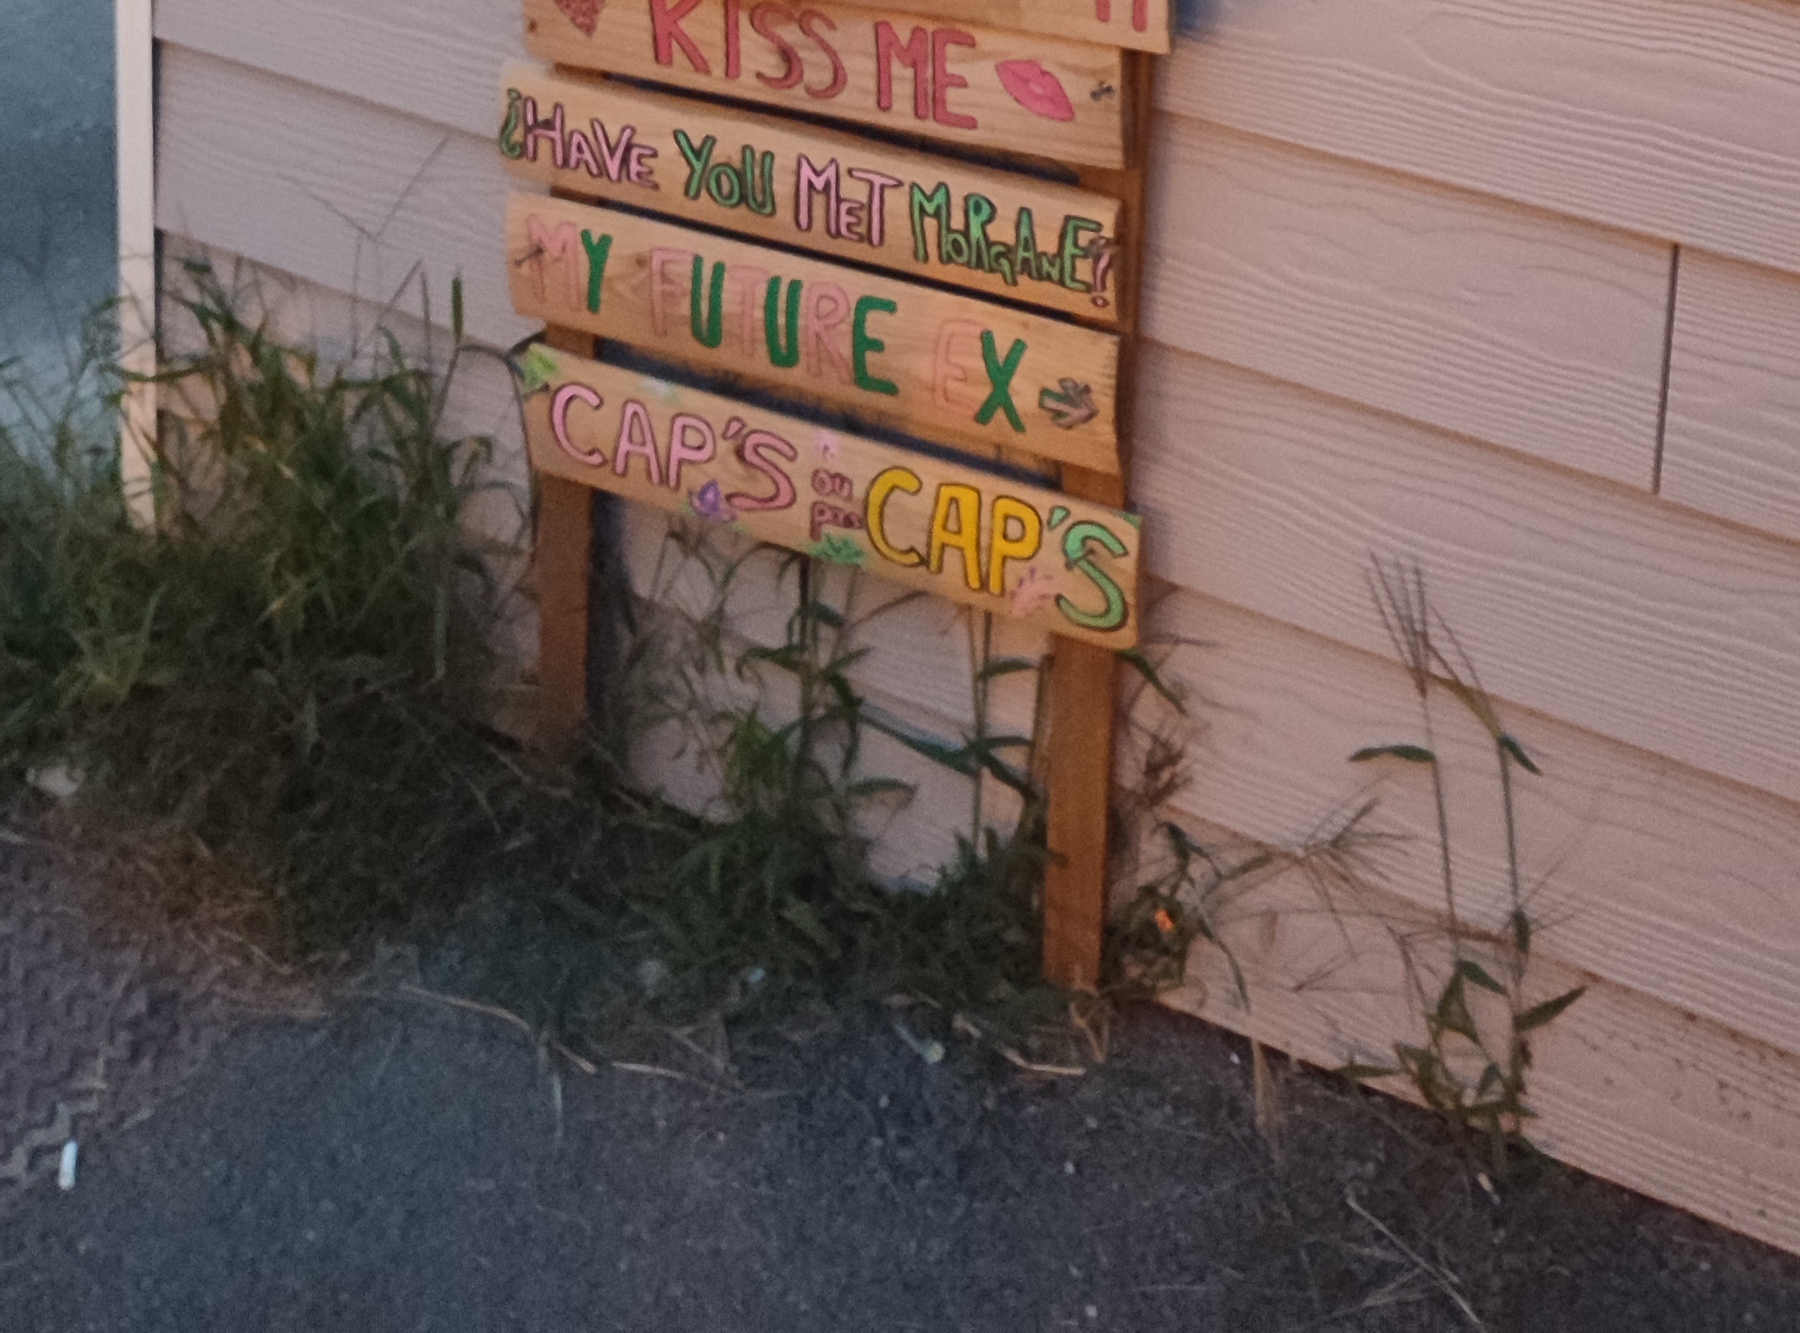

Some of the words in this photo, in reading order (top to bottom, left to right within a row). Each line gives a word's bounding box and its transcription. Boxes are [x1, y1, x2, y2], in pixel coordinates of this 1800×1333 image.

[874, 20, 978, 130] ME
[674, 129, 775, 216] YOU
[795, 154, 902, 246] MET
[528, 213, 612, 313] MY
[649, 246, 898, 394] FUTURE
[933, 318, 1027, 433] EX
[550, 383, 797, 512] CAP'S
[865, 466, 1129, 630] CAP'S
